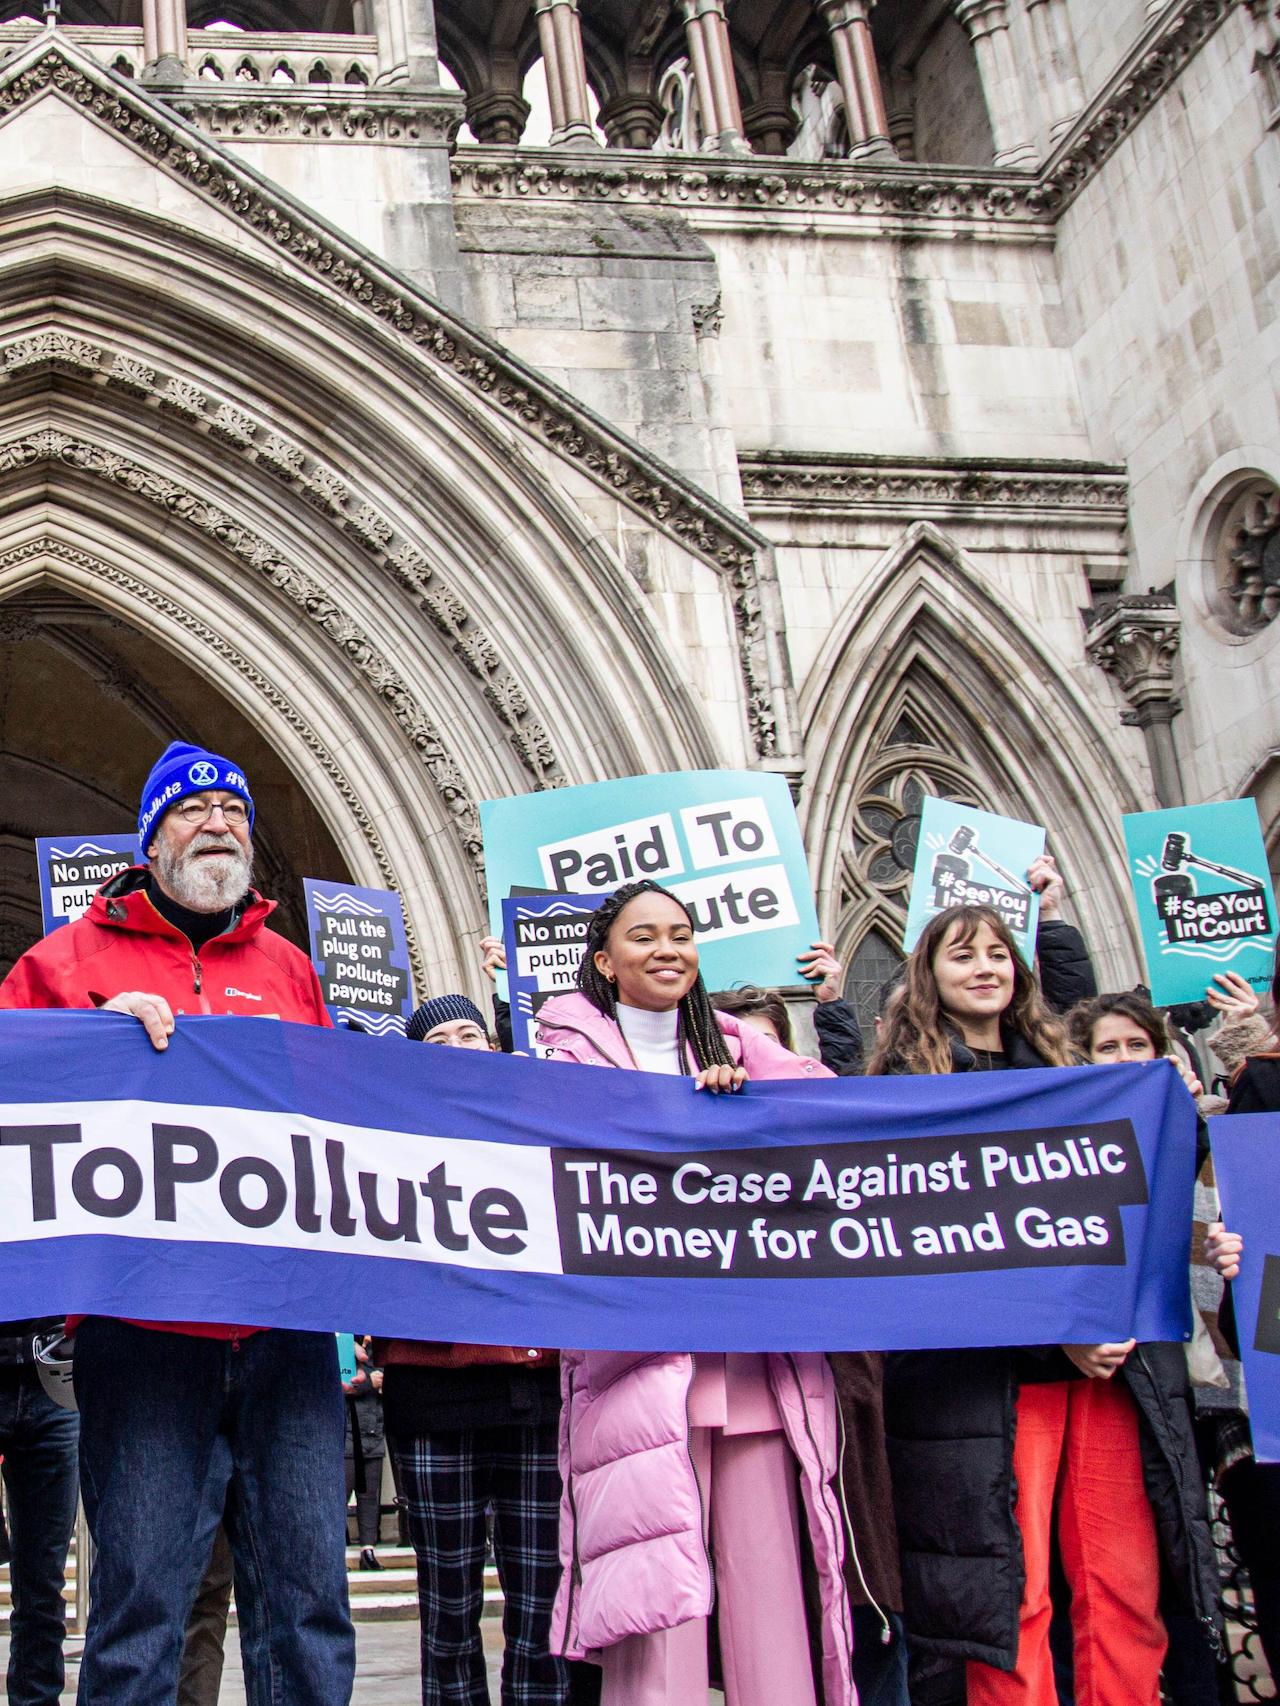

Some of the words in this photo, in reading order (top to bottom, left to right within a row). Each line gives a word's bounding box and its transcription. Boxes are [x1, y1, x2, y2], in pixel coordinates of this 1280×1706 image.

[549, 825, 670, 893] Paid
[696, 811, 764, 857] To
[52, 863, 80, 882] No
[939, 871, 1027, 912] #SeeYou
[686, 883, 780, 933] ute
[1164, 894, 1263, 919] #SeeYou
[326, 917, 358, 936] Pull
[359, 920, 387, 938] the
[519, 923, 549, 942] No
[554, 922, 590, 940] mo
[1175, 912, 1266, 938] InCourt
[323, 937, 359, 960] plug
[361, 945, 382, 959] on
[336, 962, 400, 988] polluter
[329, 983, 393, 1005] payouts
[565, 1162, 657, 1205] The
[672, 1162, 792, 1204] Case
[803, 1151, 967, 1209] Against
[982, 1137, 1127, 1190] Public
[577, 1213, 738, 1269] Money
[748, 1218, 816, 1258] for
[830, 1214, 902, 1260] Oil
[913, 1212, 1006, 1254] and
[1015, 1207, 1109, 1249] Gas
